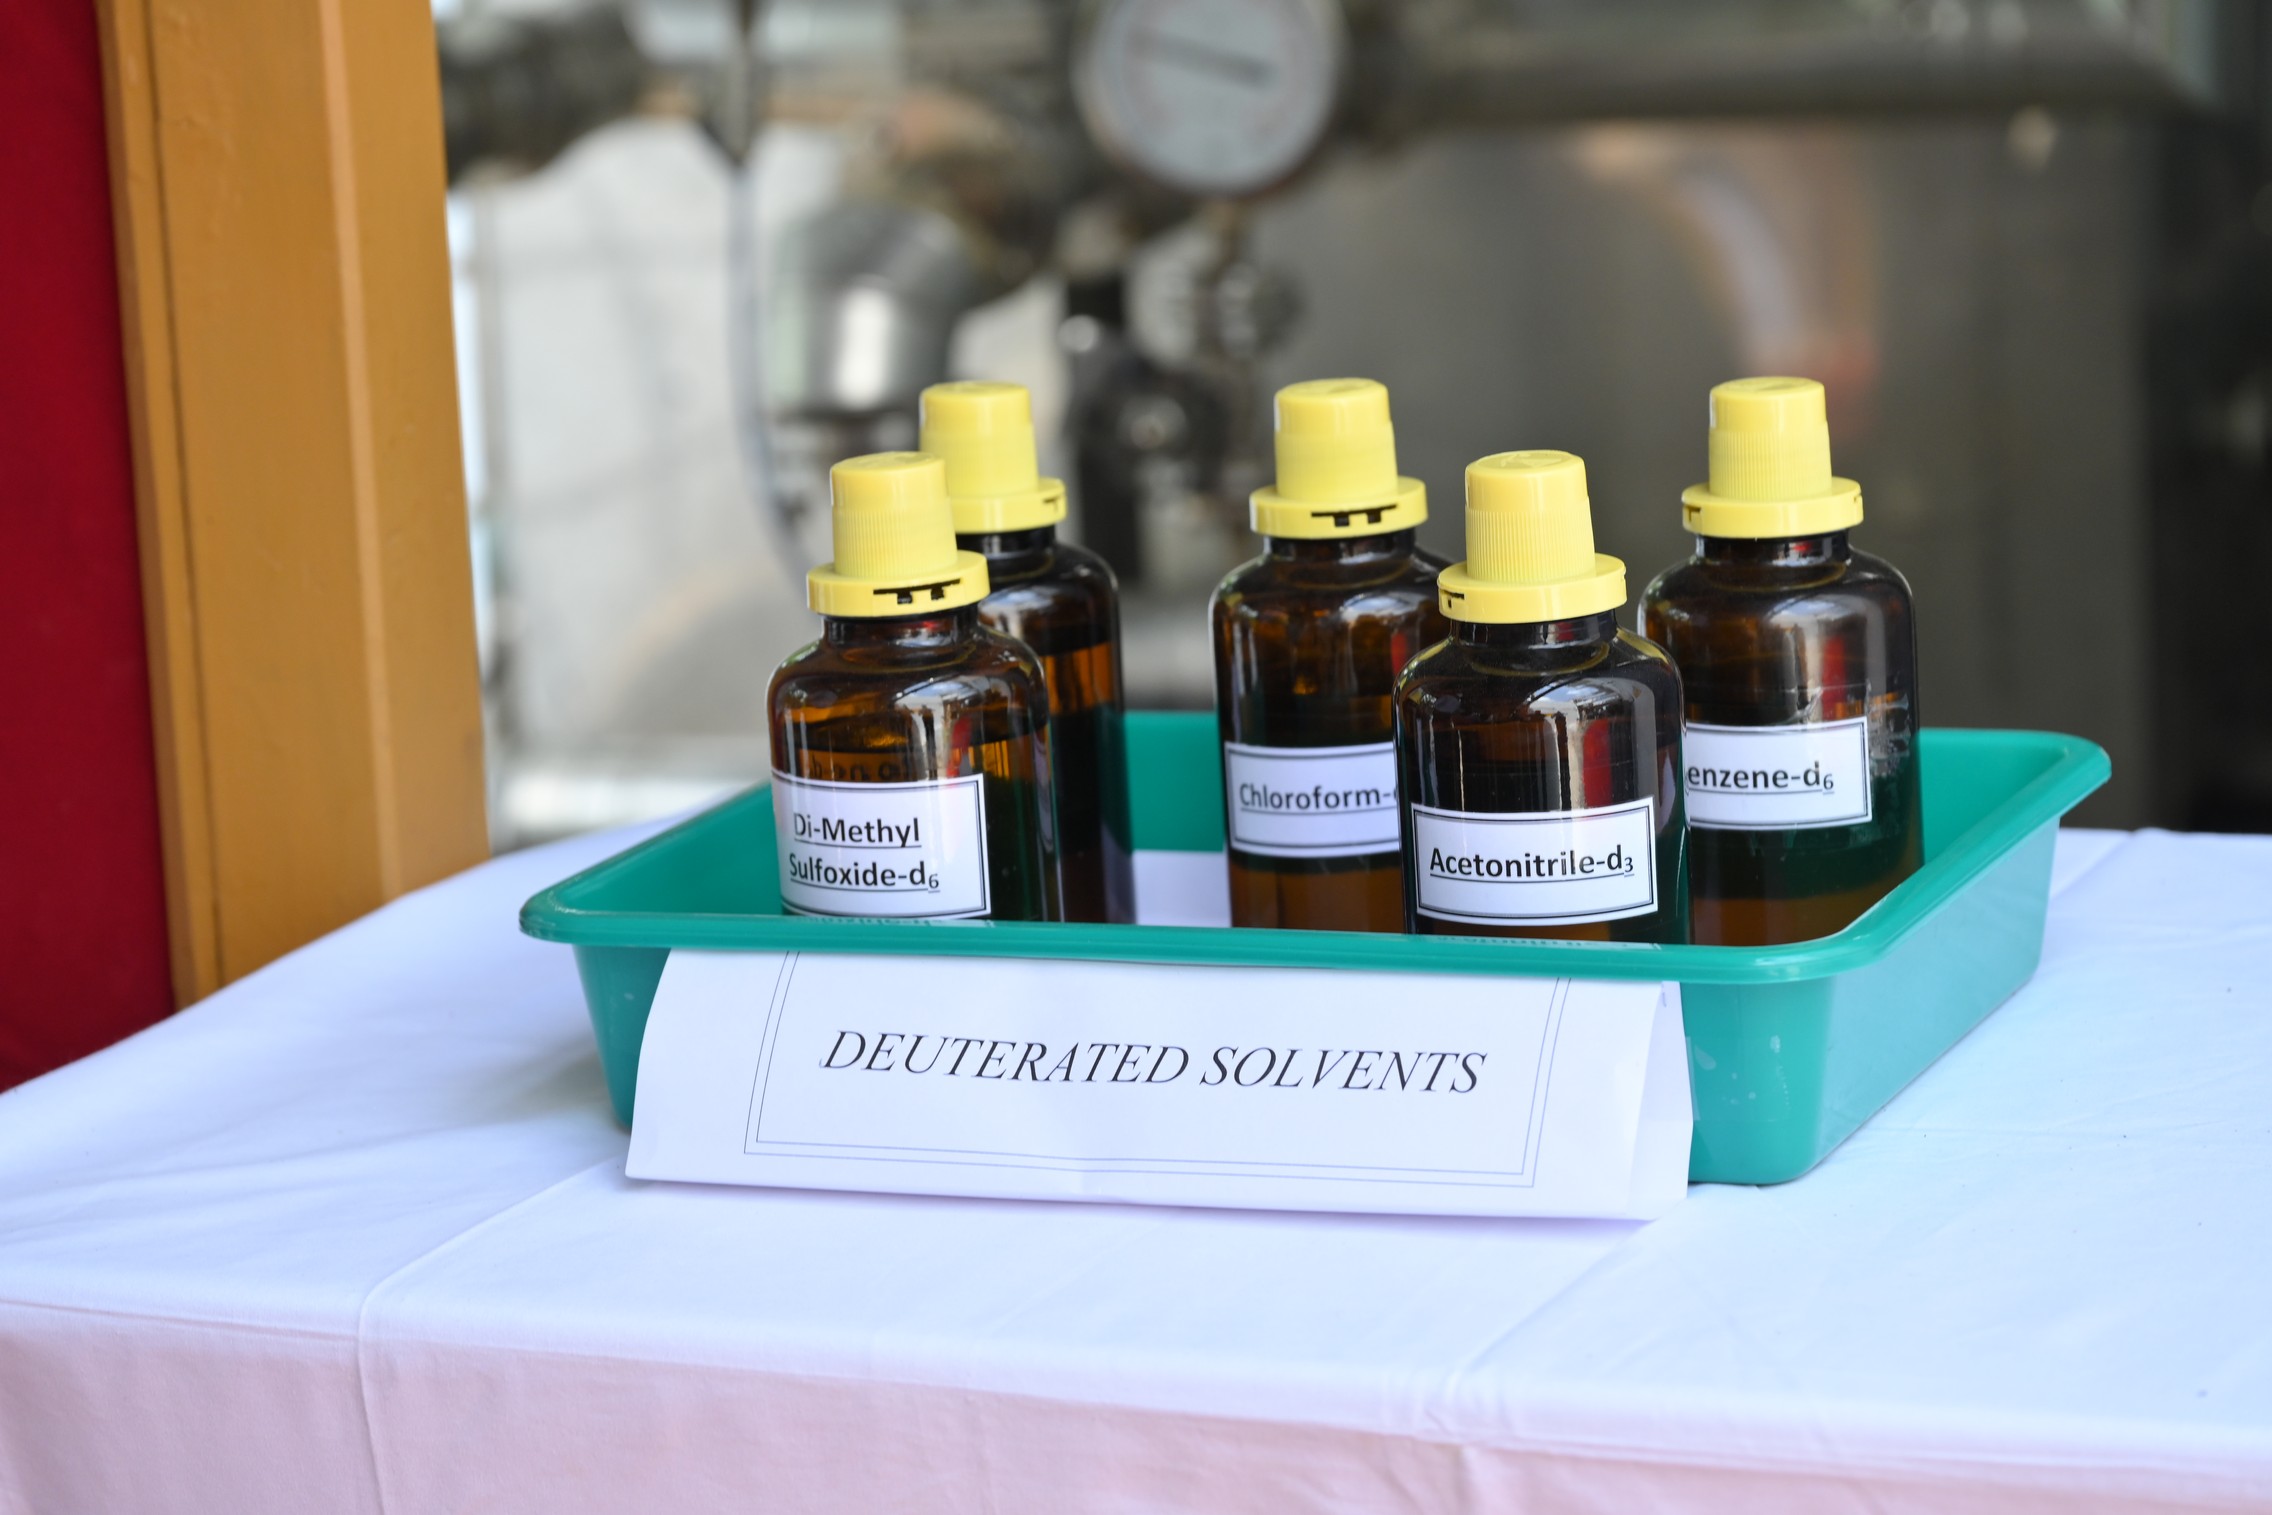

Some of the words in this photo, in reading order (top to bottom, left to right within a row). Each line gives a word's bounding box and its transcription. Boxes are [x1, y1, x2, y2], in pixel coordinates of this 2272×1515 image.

[1686, 760, 1834, 790] enzene-d6
[1239, 783, 1398, 809] Chloroform-
[793, 813, 920, 847] Di-Methyl
[789, 853, 940, 889] Sulfoxide-d6
[1430, 844, 1634, 877] Acetonitrile-d3
[819, 1030, 1190, 1084] DEUTERATED
[1200, 1046, 1489, 1094] SOLVENTS
